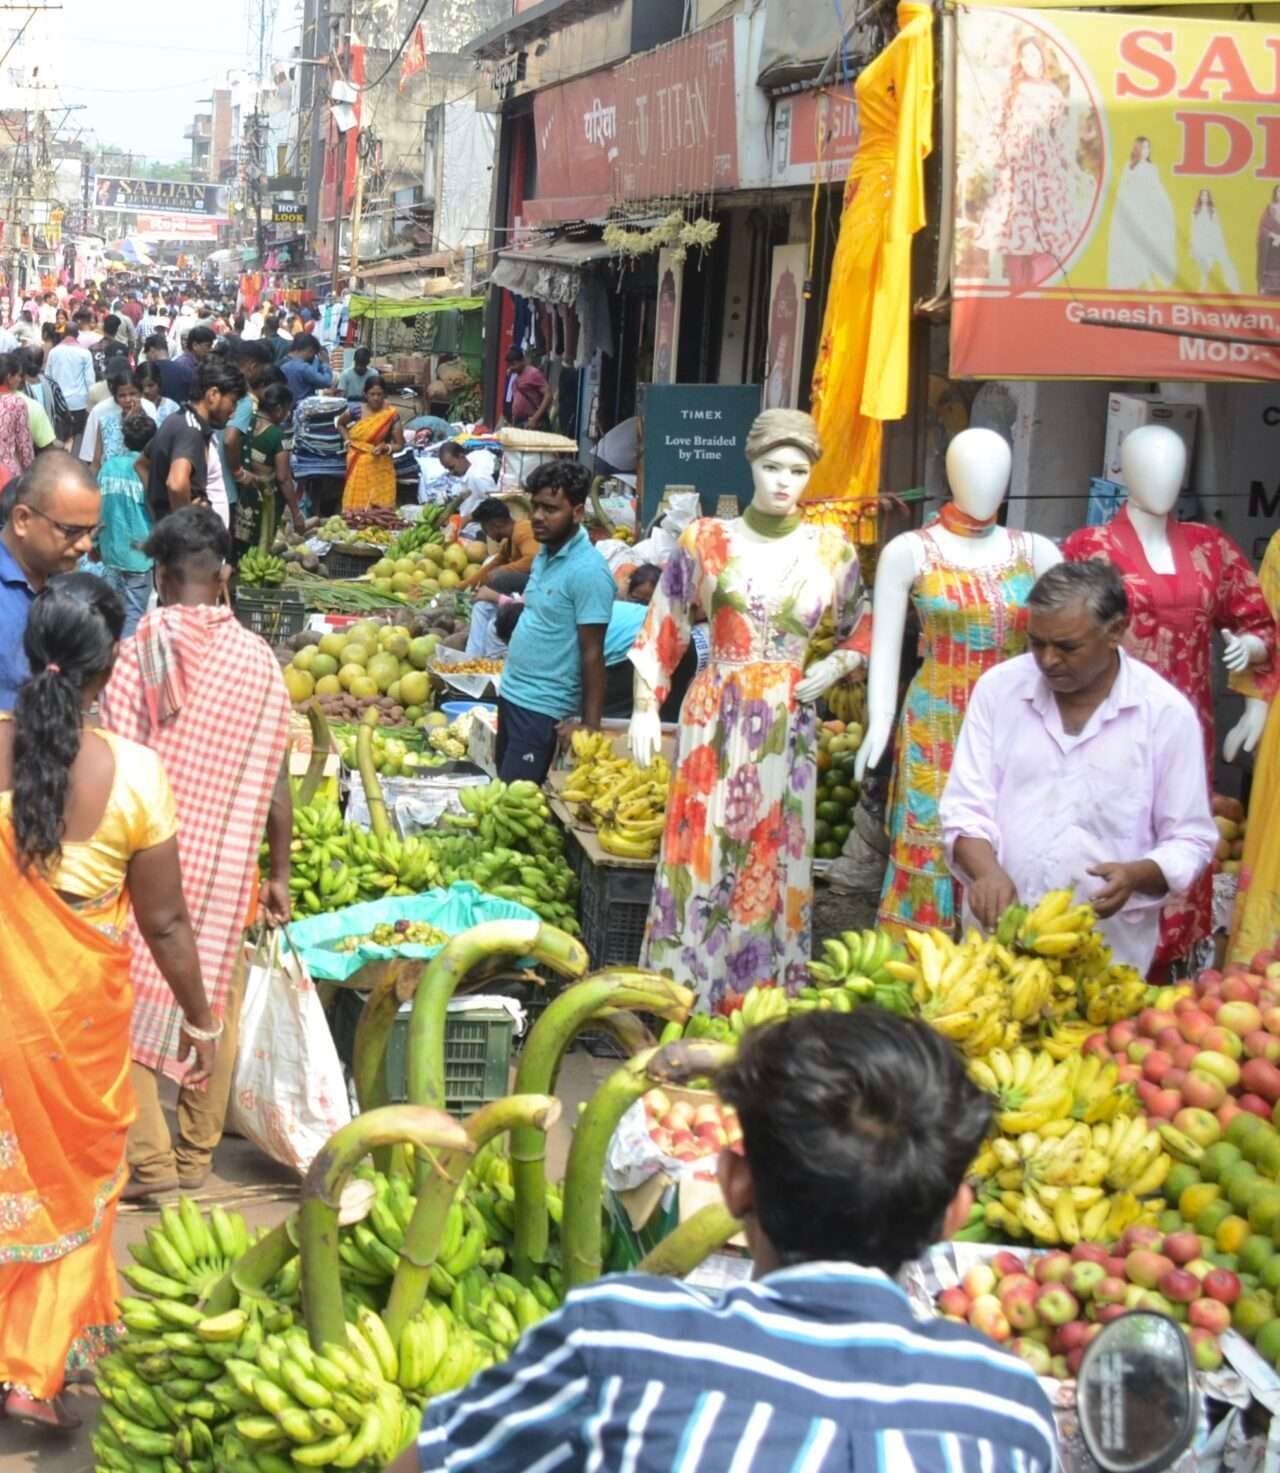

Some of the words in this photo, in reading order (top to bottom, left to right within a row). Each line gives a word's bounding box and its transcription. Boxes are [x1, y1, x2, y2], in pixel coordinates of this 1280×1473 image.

[656, 76, 711, 156] TITAN
[832, 104, 858, 138] SIN
[278, 204, 300, 213] HOT
[274, 214, 305, 222] LOOK
[1065, 302, 1163, 326] Ganesh
[680, 409, 723, 420] TIMEX
[665, 435, 691, 446] Love
[693, 435, 737, 447] Braided
[679, 448, 692, 462] by
[693, 449, 722, 460] Time
